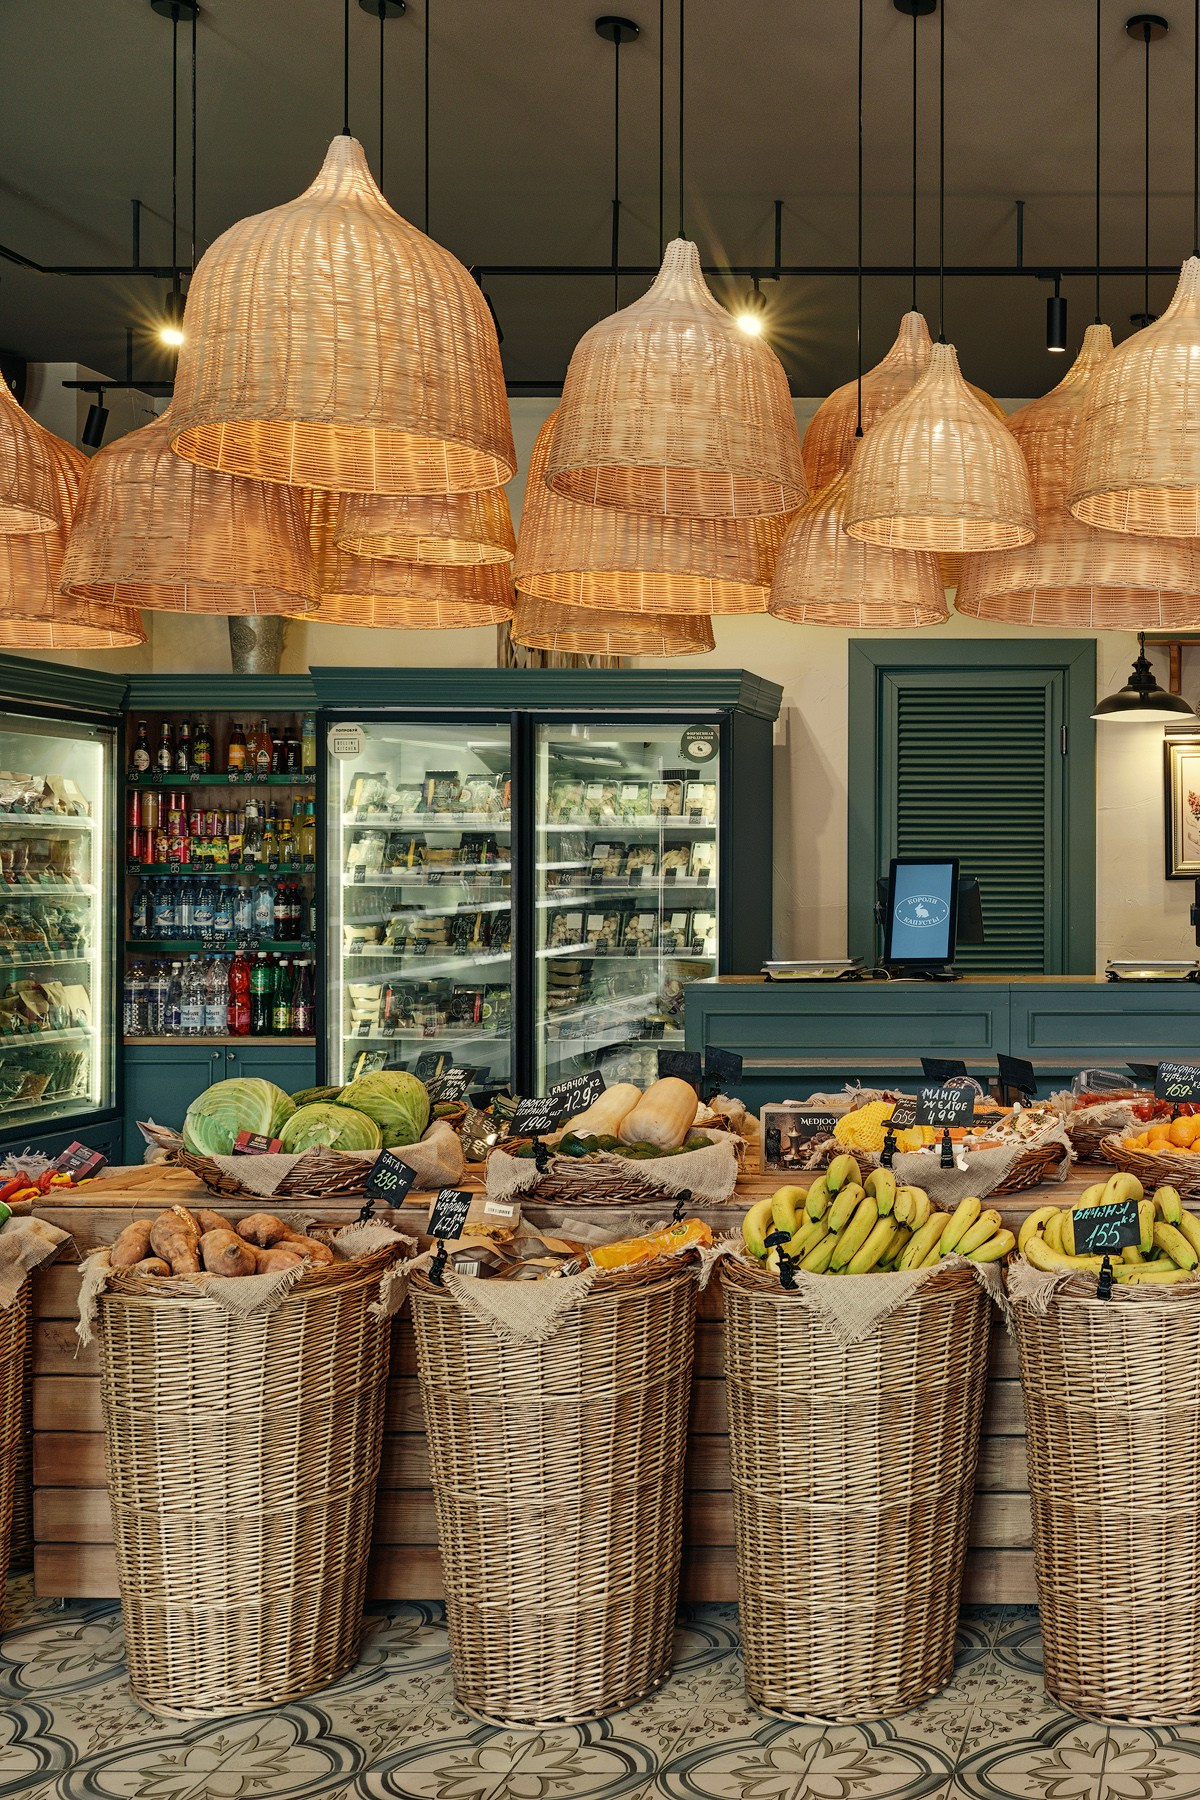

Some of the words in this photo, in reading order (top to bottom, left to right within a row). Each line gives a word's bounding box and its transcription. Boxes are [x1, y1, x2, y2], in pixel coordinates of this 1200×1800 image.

[907, 896, 938, 905] КОРОЛИ
[903, 916, 940, 926] КАПУСТЫ
[552, 1075, 589, 1095] КАБАЧОК
[921, 1088, 961, 1101] МАНГО
[927, 1110, 957, 1125] 499
[382, 1153, 407, 1174] БАТАТ
[1085, 1220, 1121, 1248] 155
